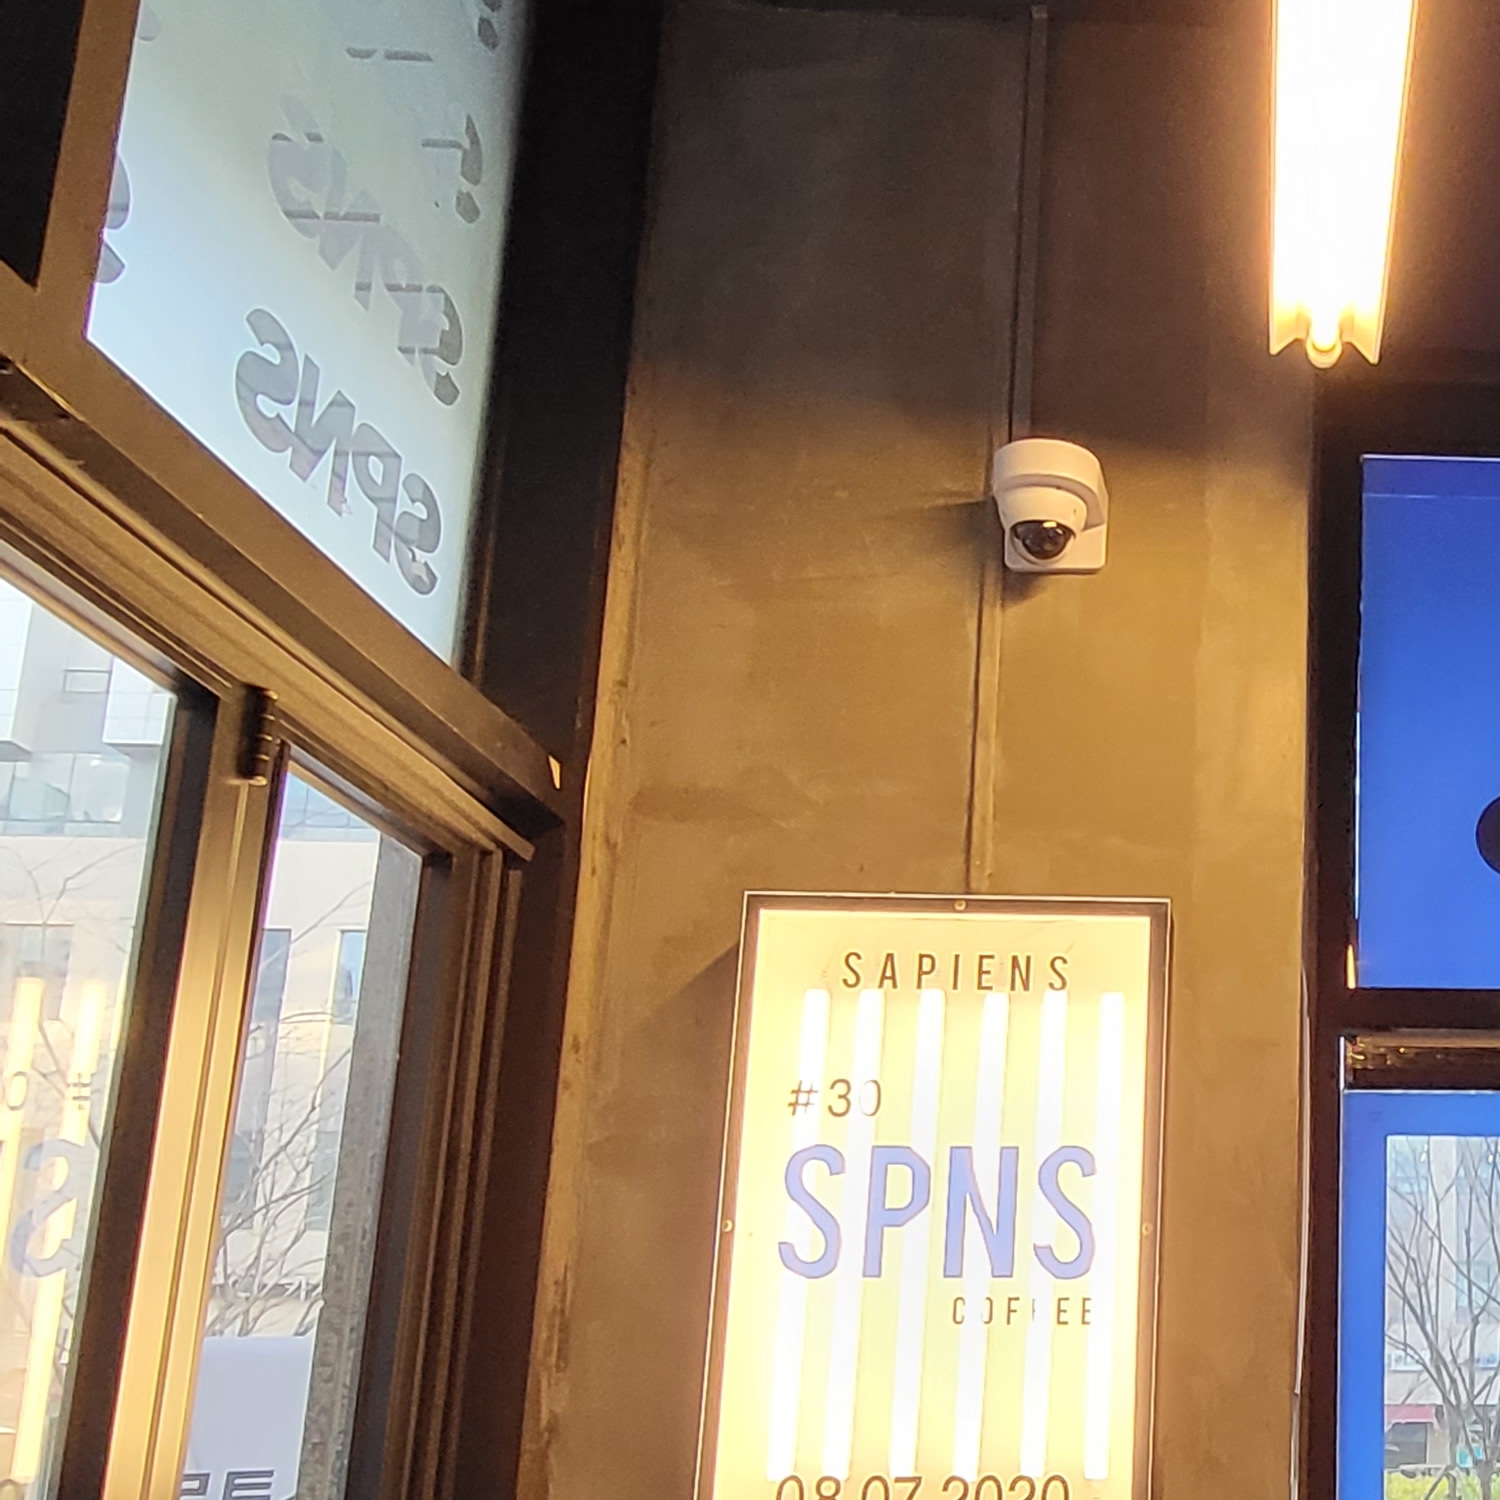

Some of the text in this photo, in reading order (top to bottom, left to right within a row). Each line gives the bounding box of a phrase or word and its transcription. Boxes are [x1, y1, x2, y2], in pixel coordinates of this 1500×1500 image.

[842, 951, 1071, 992] SAPIENS
[788, 1078, 882, 1117] #30
[777, 1143, 1097, 1280] SPNS
